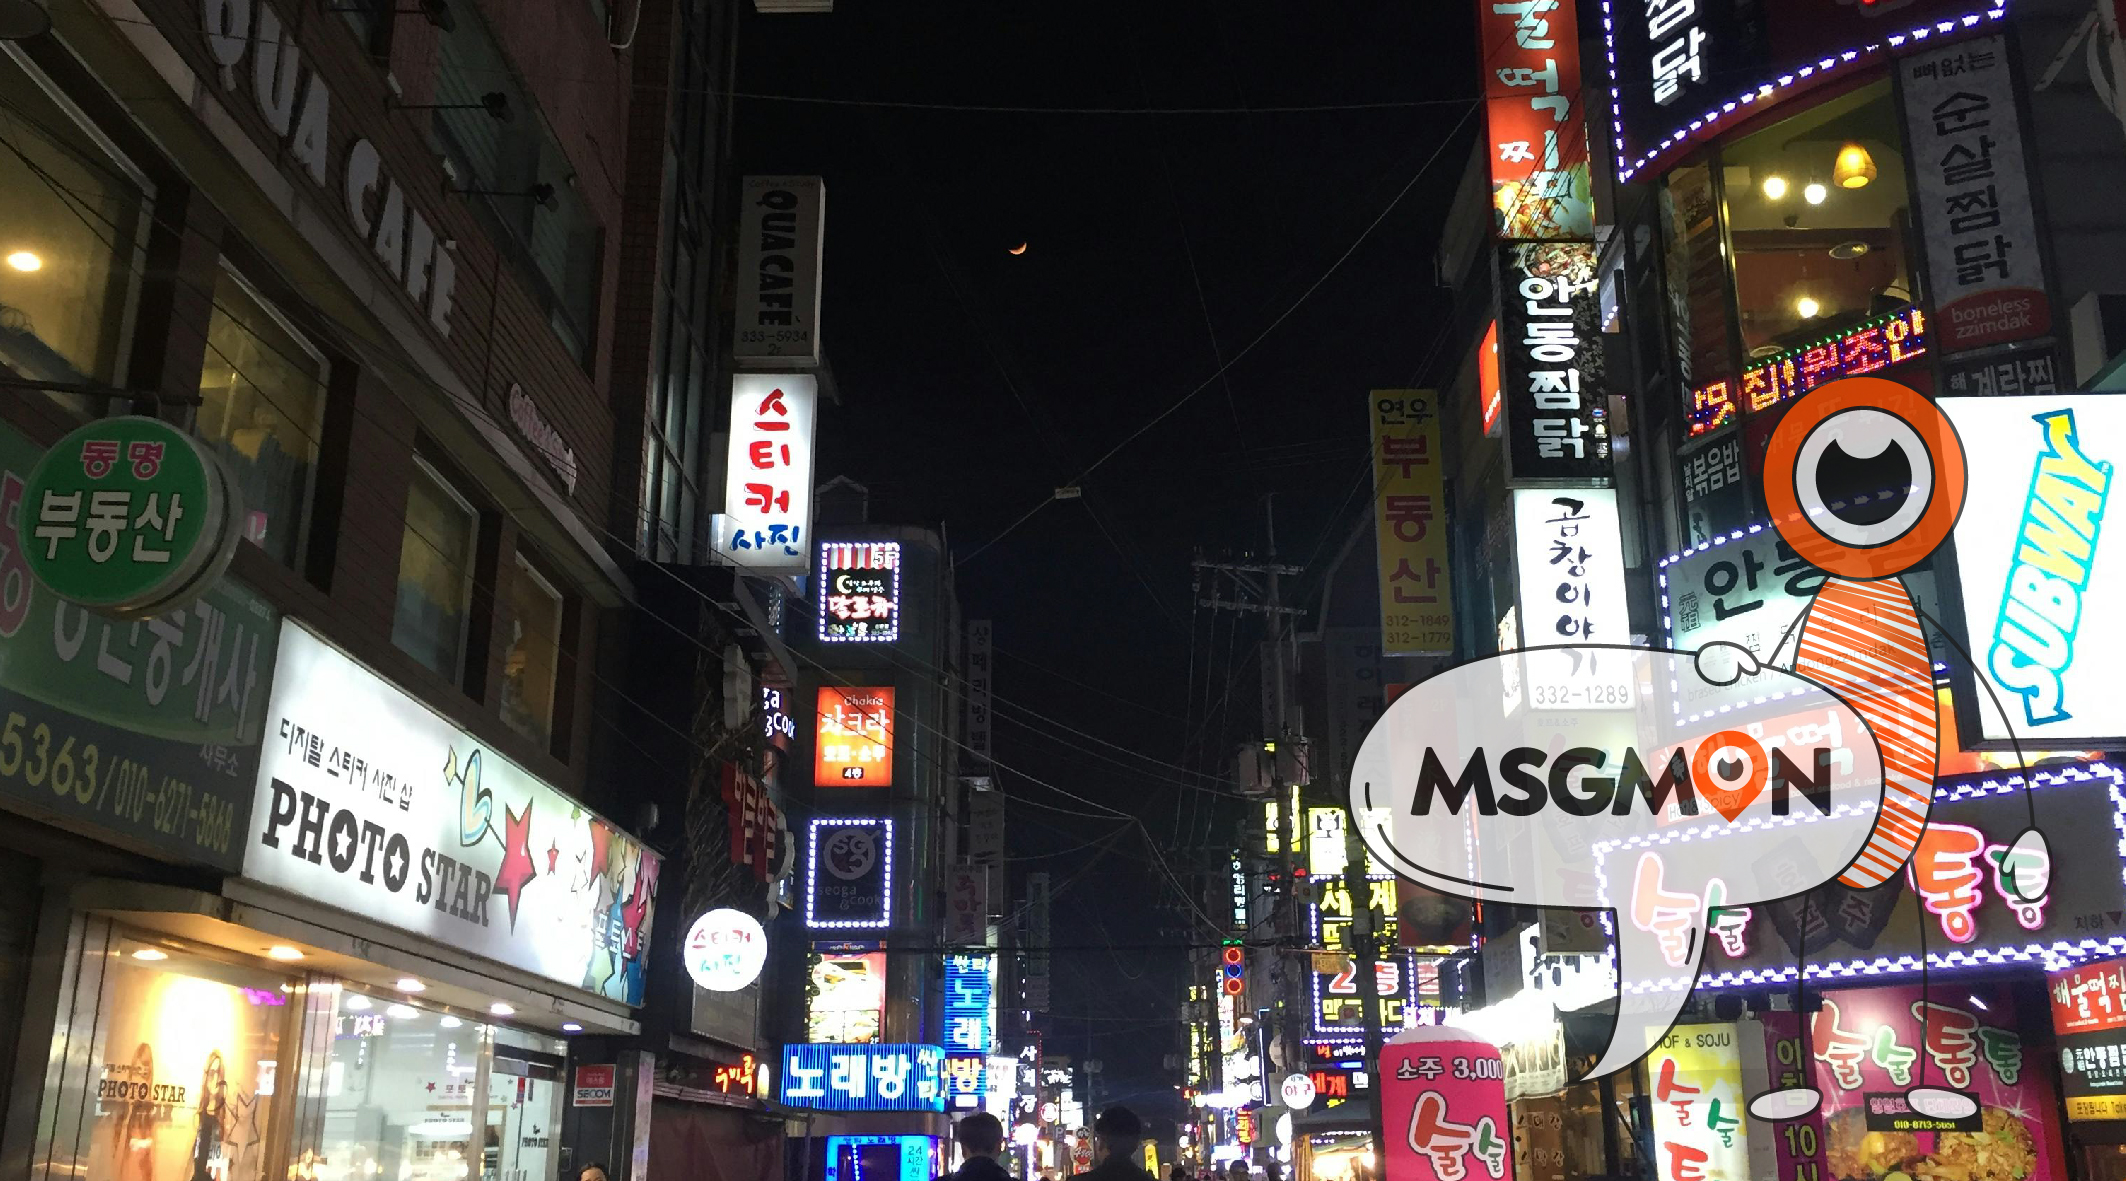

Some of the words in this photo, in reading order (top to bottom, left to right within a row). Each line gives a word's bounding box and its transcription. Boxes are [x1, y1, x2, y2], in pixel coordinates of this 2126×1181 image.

[1913, 51, 1996, 79] 뼈없는
[1931, 90, 2012, 286] 순살찜닭
[1951, 297, 2031, 324] boneless
[1955, 314, 2032, 340] zzimdak
[1519, 276, 1589, 459] 안동찜닭
[1971, 355, 2056, 396] 계란찜
[1377, 398, 1433, 425] 연우
[81, 440, 166, 480] 동명
[745, 387, 791, 514] 스티커
[1692, 439, 1741, 497] 볶음밥
[35, 489, 184, 563] 부동산
[1382, 434, 1441, 604] 부동산
[729, 524, 800, 557] 사진
[1988, 408, 2112, 726] SUBWAY
[1386, 614, 1450, 627] 312-1849
[1387, 632, 1451, 645] 312-1779
[1535, 685, 1629, 705] 332-1289
[200, 744, 239, 777] 사무소
[327, 746, 369, 791] 스티커
[373, 769, 397, 804] 사진
[262, 777, 410, 893] PHOTO
[415, 847, 492, 927] STAR
[692, 928, 751, 950] 스티커
[701, 954, 741, 975] 사진
[952, 978, 984, 1093] 노래방
[1696, 1033, 1731, 1048] SOJU
[786, 1053, 912, 1099] 노래방
[1398, 1058, 1443, 1080] 소주
[1454, 1058, 1503, 1080] 3,000
[99, 1080, 149, 1101] PHOTO
[153, 1084, 186, 1103] STAR
[577, 1089, 611, 1099] SECOM
[908, 1146, 923, 1155] 24
